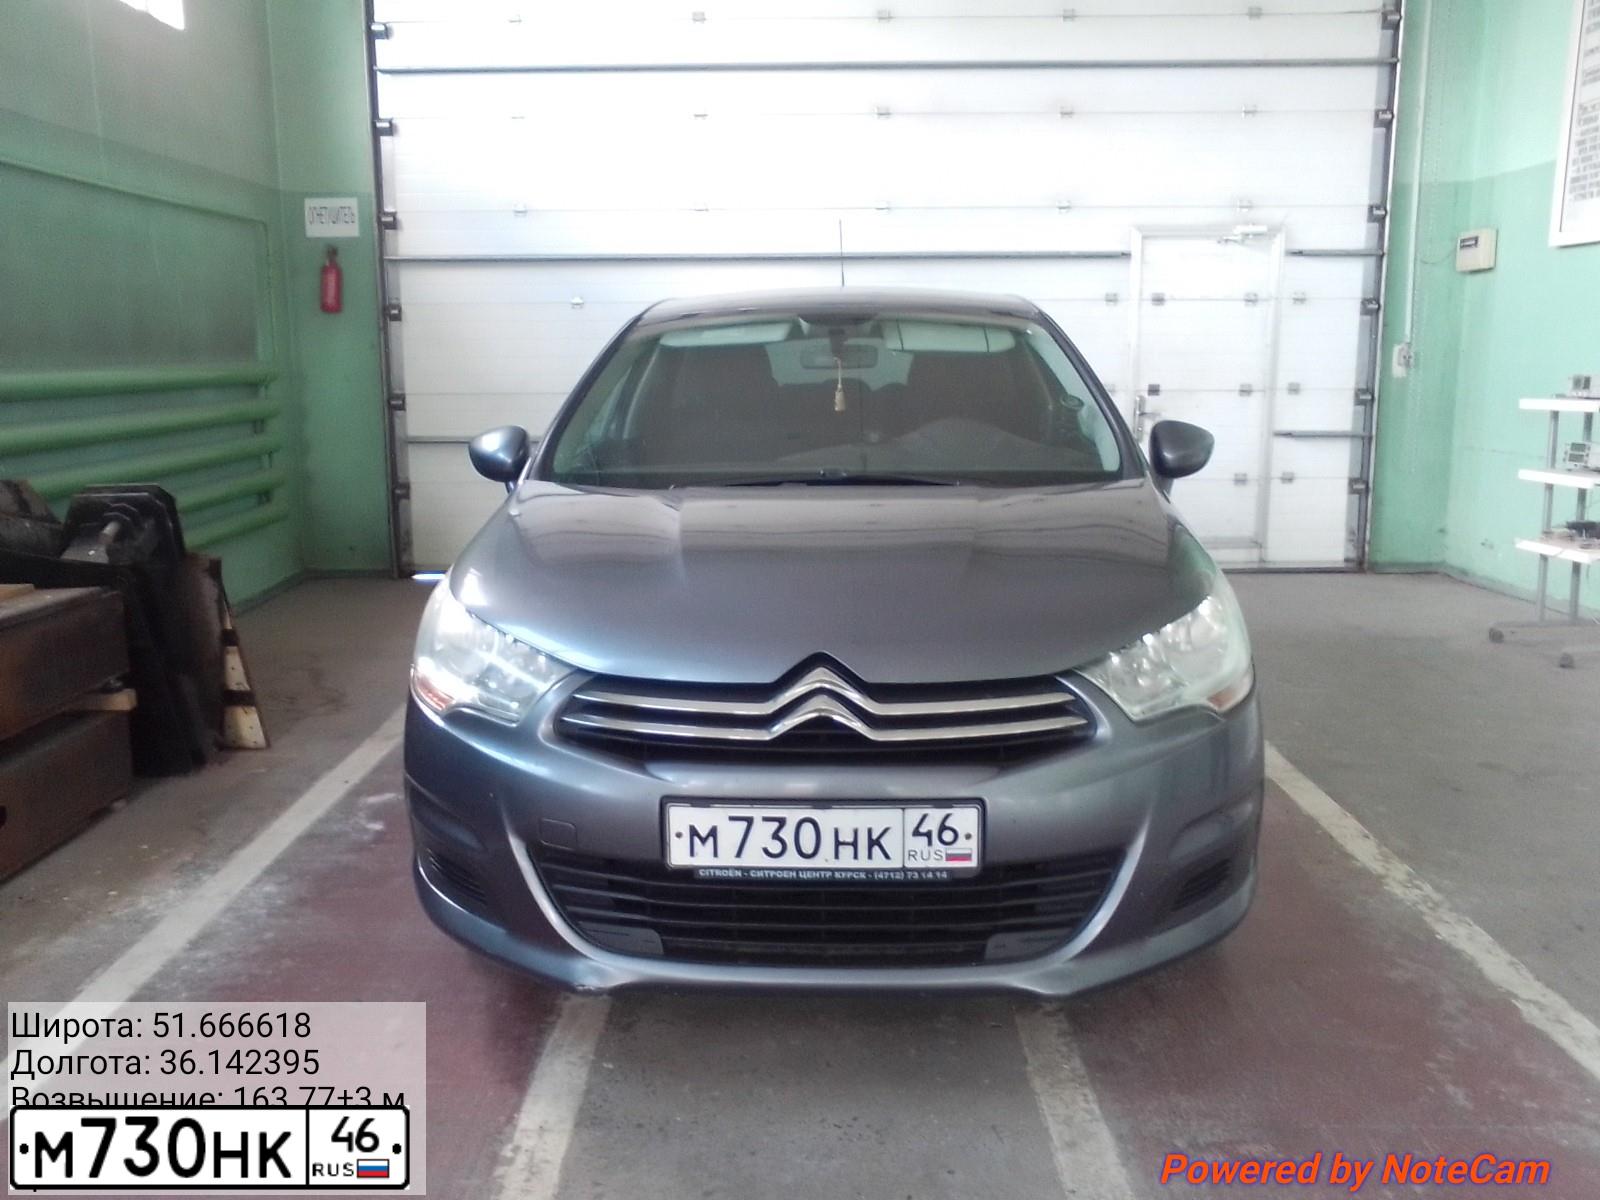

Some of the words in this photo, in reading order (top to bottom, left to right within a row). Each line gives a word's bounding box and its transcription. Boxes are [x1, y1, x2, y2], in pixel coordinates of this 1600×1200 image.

[911, 813, 960, 847] 46
[907, 848, 944, 862] RUS
[798, 870, 832, 880] ЦЕНТР
[834, 870, 867, 880] КУРСК
